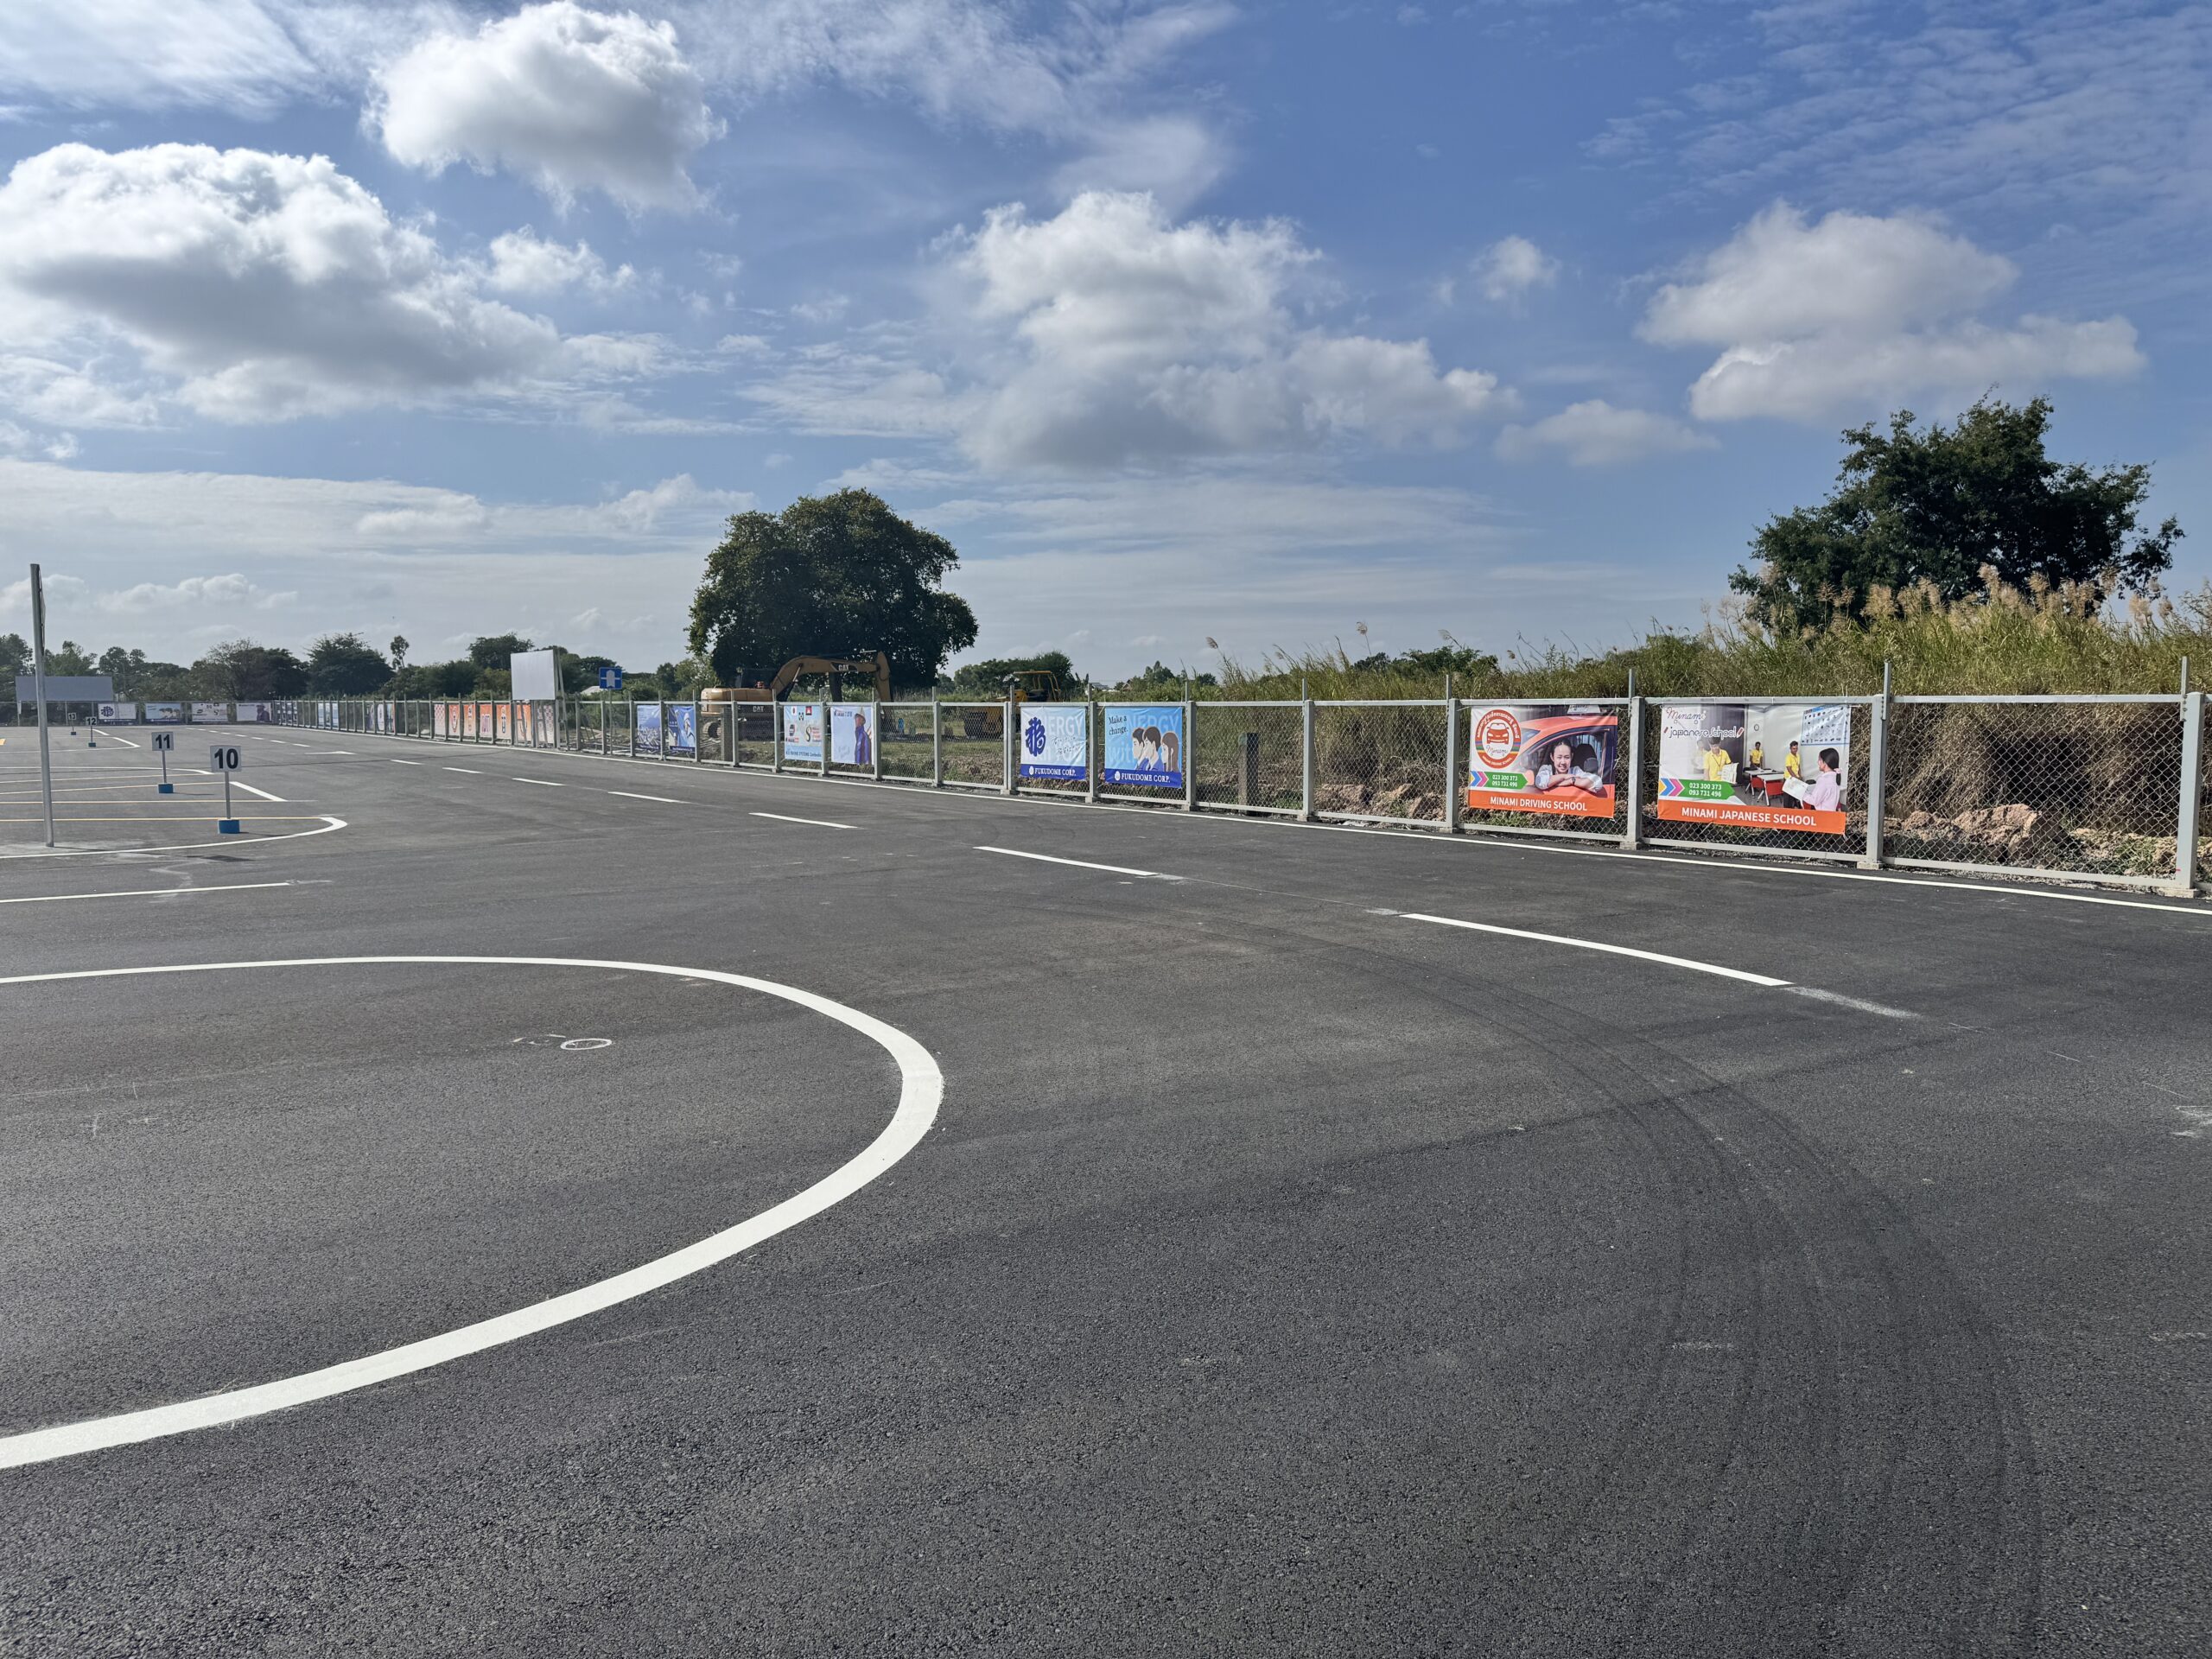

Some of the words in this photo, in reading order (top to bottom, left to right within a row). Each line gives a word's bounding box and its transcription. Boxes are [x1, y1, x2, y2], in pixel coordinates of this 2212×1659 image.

[86, 717, 97, 726] 12
[1108, 715, 1122, 724] Make
[1109, 726, 1128, 736] change.
[156, 734, 170, 749] 11
[214, 748, 238, 769] 10
[1121, 772, 1153, 782] FUKUDOME
[1490, 797, 1518, 806] MINAMI
[1520, 798, 1552, 809] DRIVING
[1553, 801, 1587, 811] SCHOOL
[1681, 807, 1717, 819] MINAMI
[1719, 810, 1770, 823] JAPANESE
[1773, 813, 1817, 826] SCHOOL
